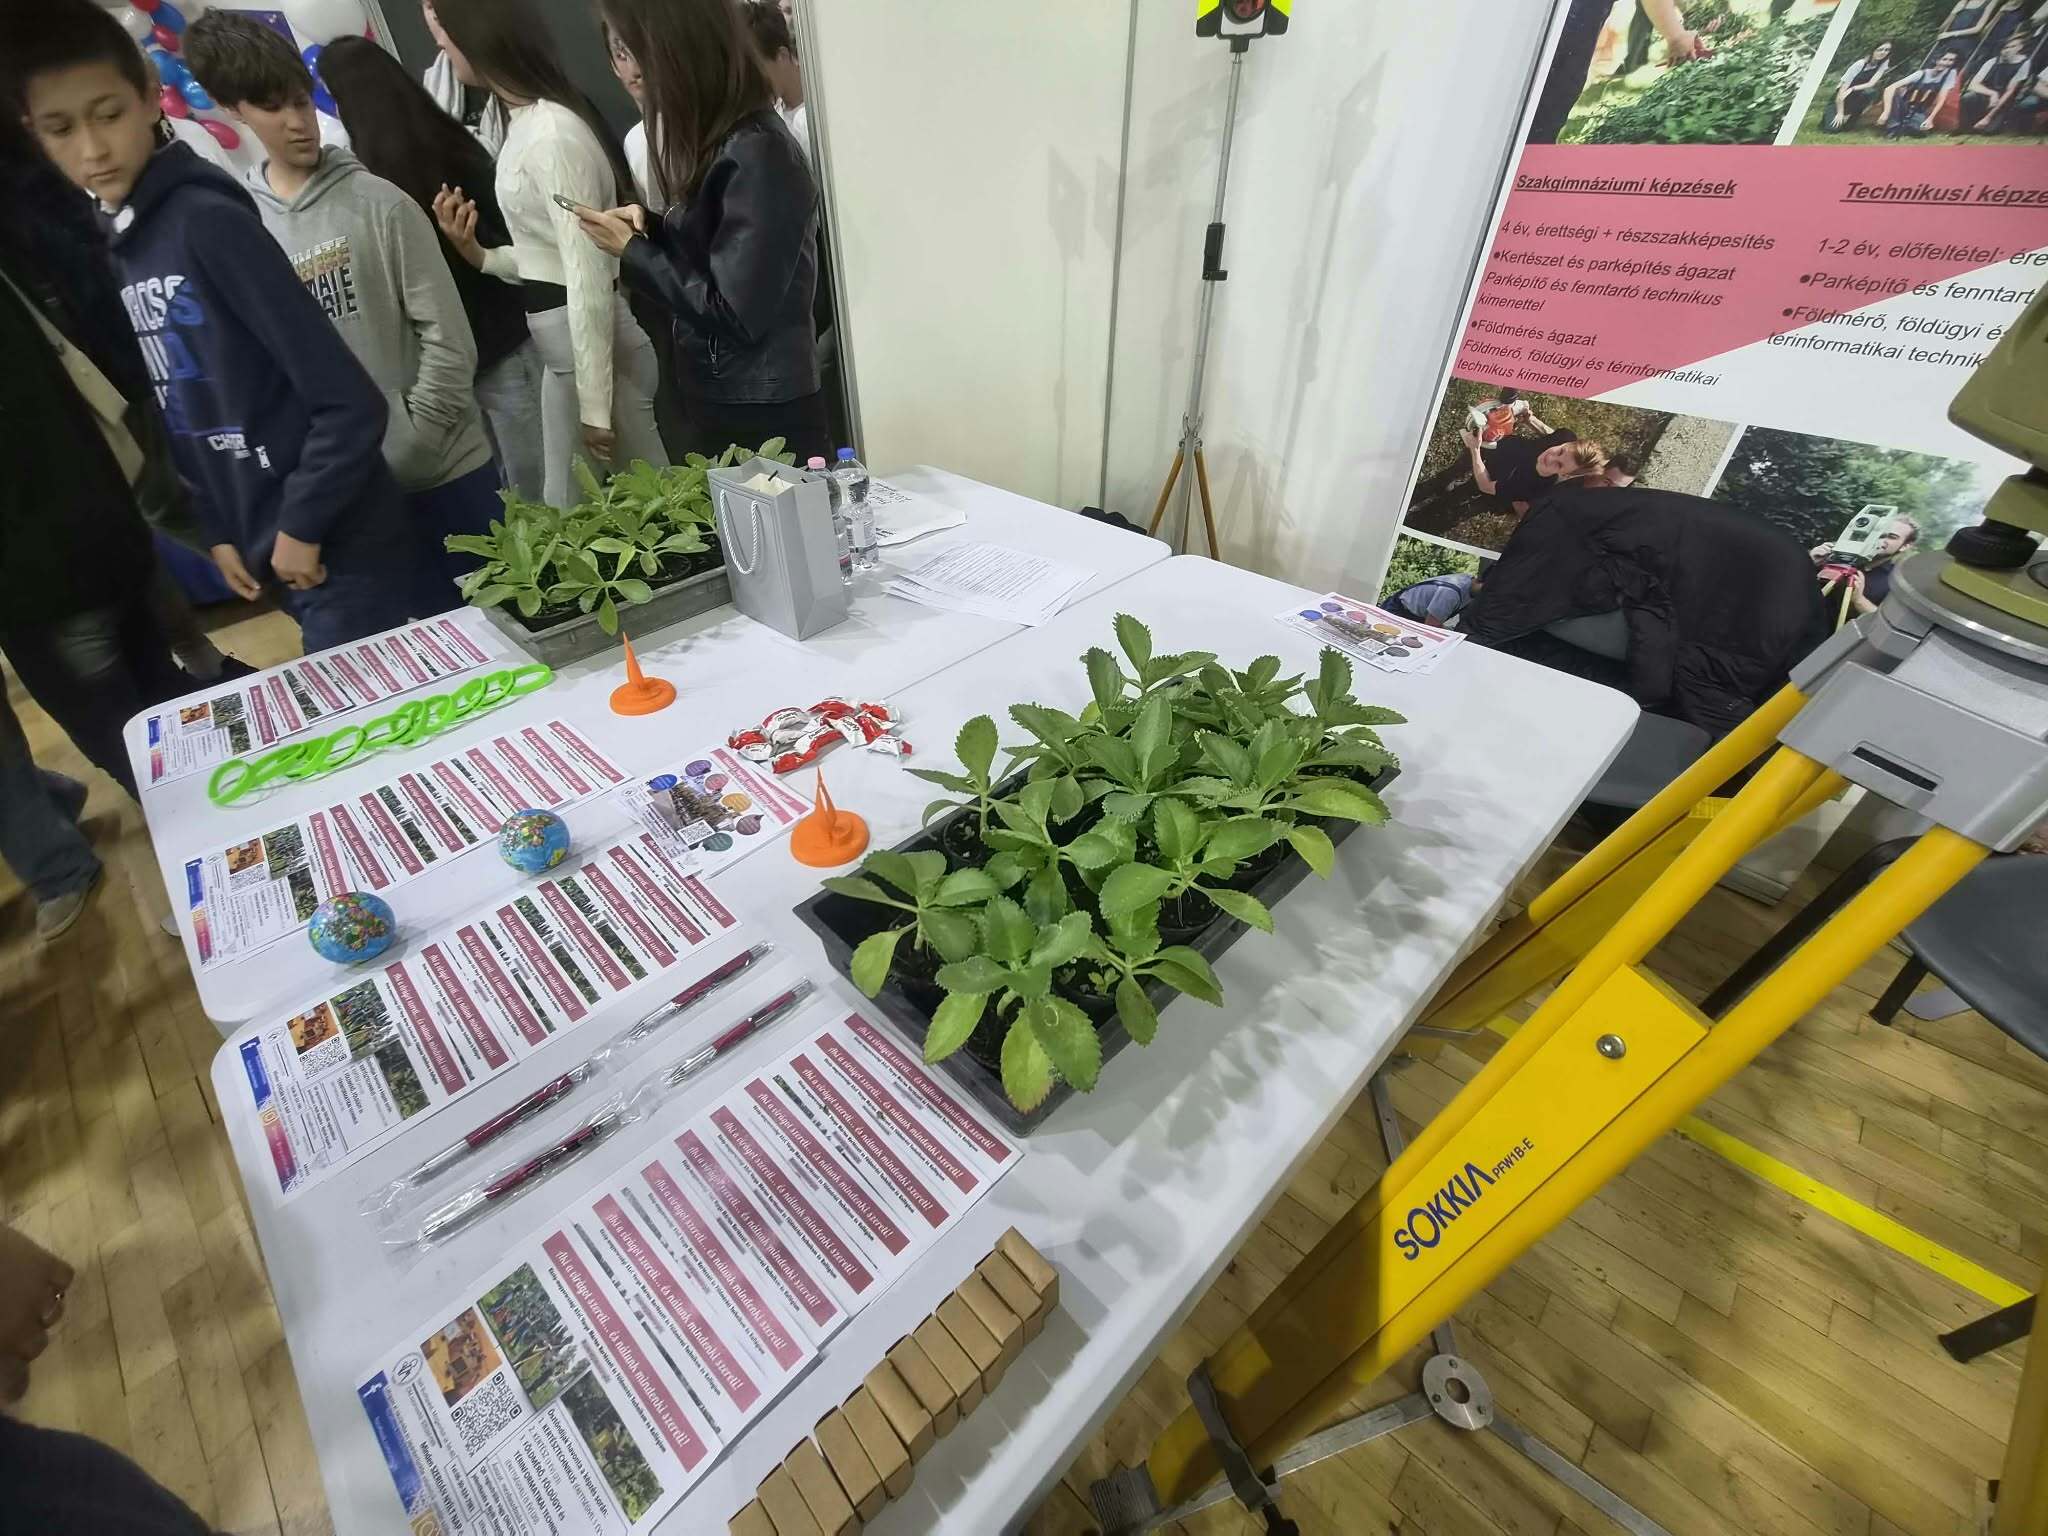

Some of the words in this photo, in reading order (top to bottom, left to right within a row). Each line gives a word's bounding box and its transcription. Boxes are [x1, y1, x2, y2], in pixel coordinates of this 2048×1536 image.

[1516, 174, 1645, 193] Szakgimnáziumi
[1648, 177, 1737, 197] képzések
[1846, 182, 1973, 202] Technikusi
[1502, 222, 1511, 234] 4
[1512, 224, 1530, 237] év,
[1535, 223, 1598, 240] érettségi
[1602, 229, 1612, 238] +
[1616, 228, 1776, 250] részszakképesítés
[1500, 250, 1564, 267] Kertészet
[1567, 254, 1584, 268] és
[1588, 257, 1671, 277] parképítés
[1675, 263, 1736, 281] ágazat
[1817, 238, 1849, 254] 1-2
[1853, 242, 1880, 259] év,
[2009, 248, 2048, 266] ére
[1485, 271, 1548, 290] Parképítő
[1551, 277, 1568, 291] és
[1571, 279, 1640, 299] fenntartó
[1642, 286, 1723, 307] technikus
[1808, 272, 1908, 295] Parképítő
[1912, 283, 1938, 297] és
[1943, 282, 2036, 305] fenntart
[1479, 294, 1544, 312] kimenettel
[1477, 319, 1543, 339] Földmérés
[1548, 327, 1597, 347] ágazat
[1896, 315, 1984, 341] földügyi
[1986, 325, 2002, 340] é
[1527, 348, 1584, 370] földügyi
[1586, 357, 1605, 371] és
[1607, 357, 1722, 386] térinformatikai
[1908, 346, 1988, 368] technik
[1457, 358, 1515, 378] technikus
[1516, 367, 1590, 389] kimenettel
[1394, 1162, 1496, 1260] SOKKIA
[1491, 1137, 1535, 1180] PFW1B-E
[538, 1507, 562, 1536] TECHNIK
